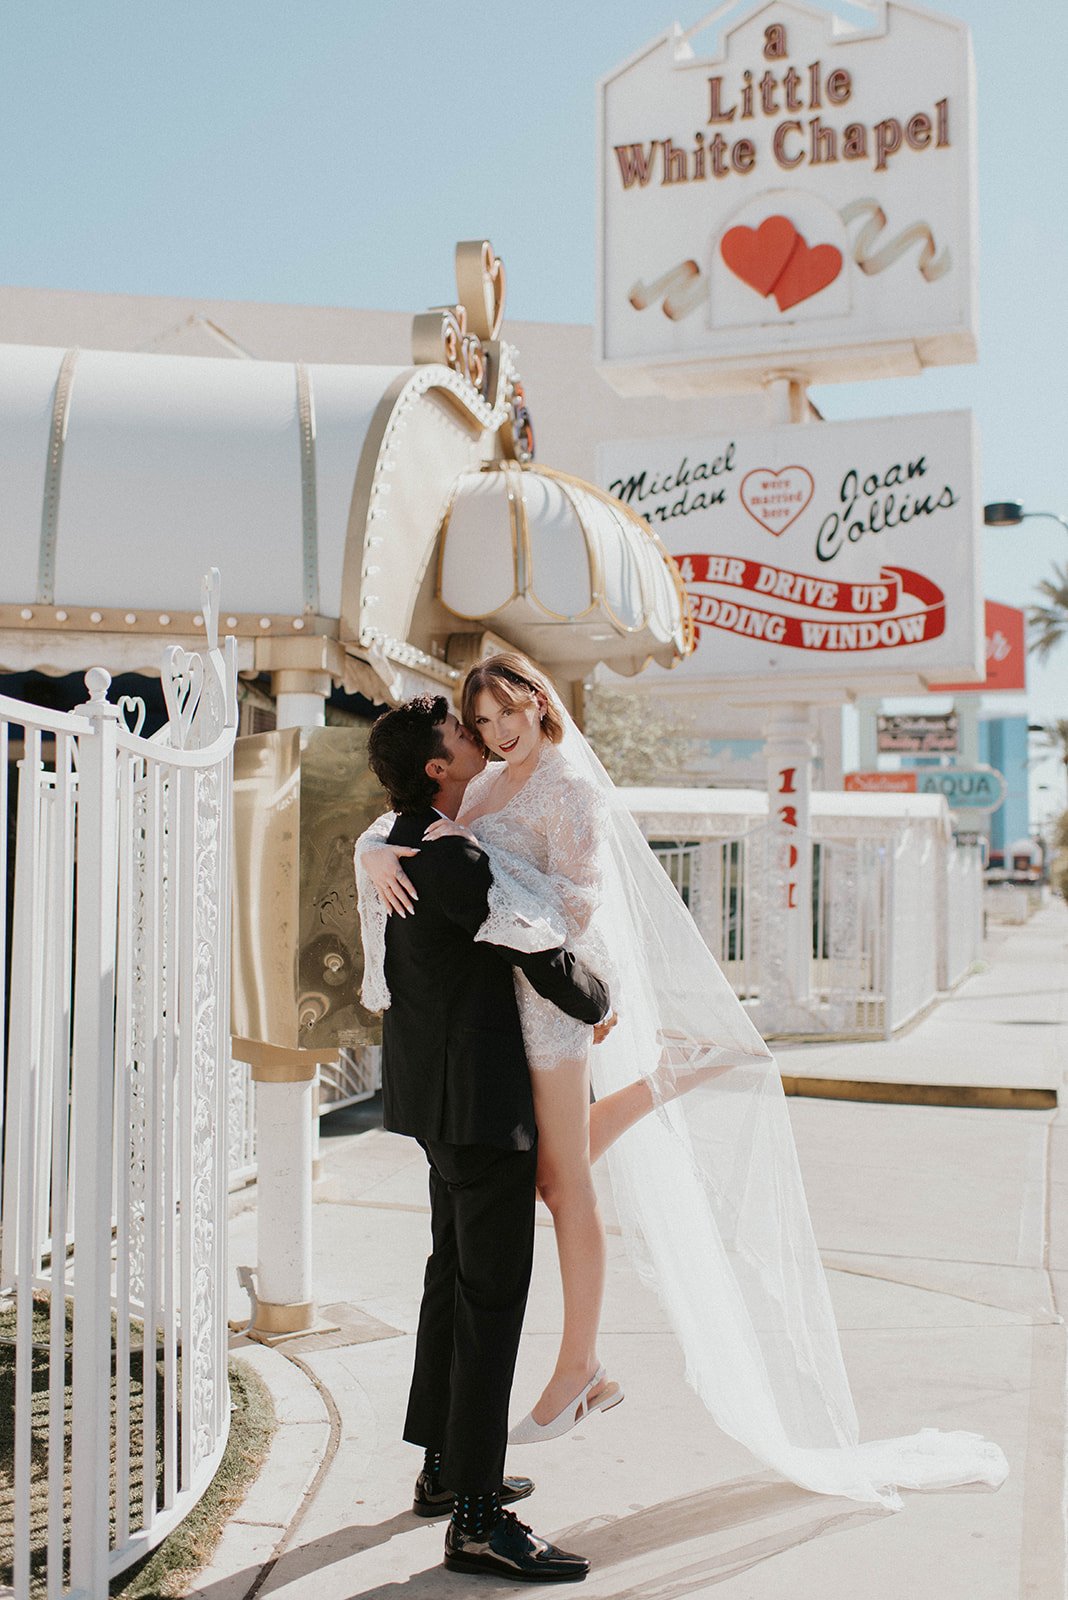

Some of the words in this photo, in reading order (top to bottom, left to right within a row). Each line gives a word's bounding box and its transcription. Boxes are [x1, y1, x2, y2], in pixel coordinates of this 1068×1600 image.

[763, 23, 788, 59] a
[708, 61, 852, 125] Little
[614, 132, 756, 190] White
[773, 98, 951, 172] Chapel
[609, 442, 736, 503] Michael
[840, 455, 929, 525] Joan
[815, 486, 960, 562] Collins
[675, 557, 695, 582] 4
[706, 556, 746, 585] HR
[756, 570, 839, 611] DRIVE
[852, 584, 889, 612] UP
[685, 597, 787, 643] EDDING
[802, 615, 927, 649] WINDOW
[921, 776, 991, 797] AQUA
